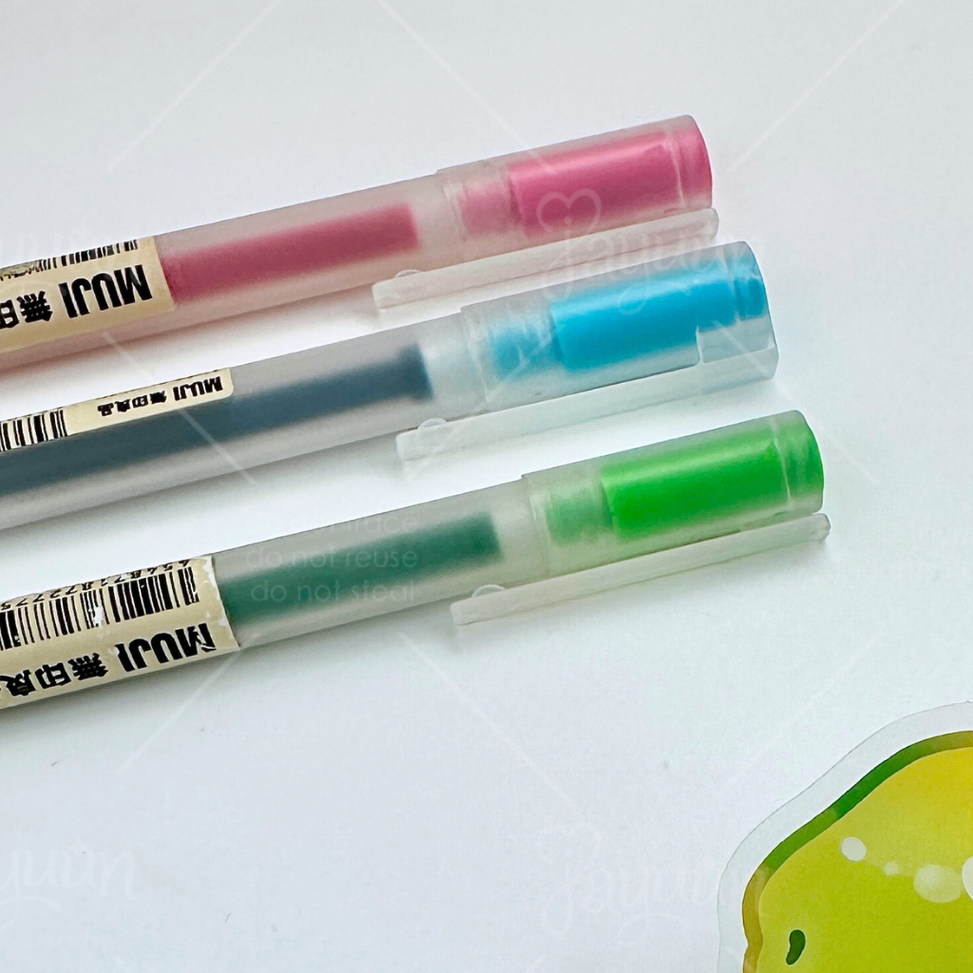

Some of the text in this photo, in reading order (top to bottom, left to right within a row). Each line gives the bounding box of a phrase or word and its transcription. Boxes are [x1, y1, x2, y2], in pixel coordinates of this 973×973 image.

[58, 264, 153, 319] MUJI
[96, 376, 224, 417] MUJI 無印良品
[114, 622, 217, 673] MUJI
